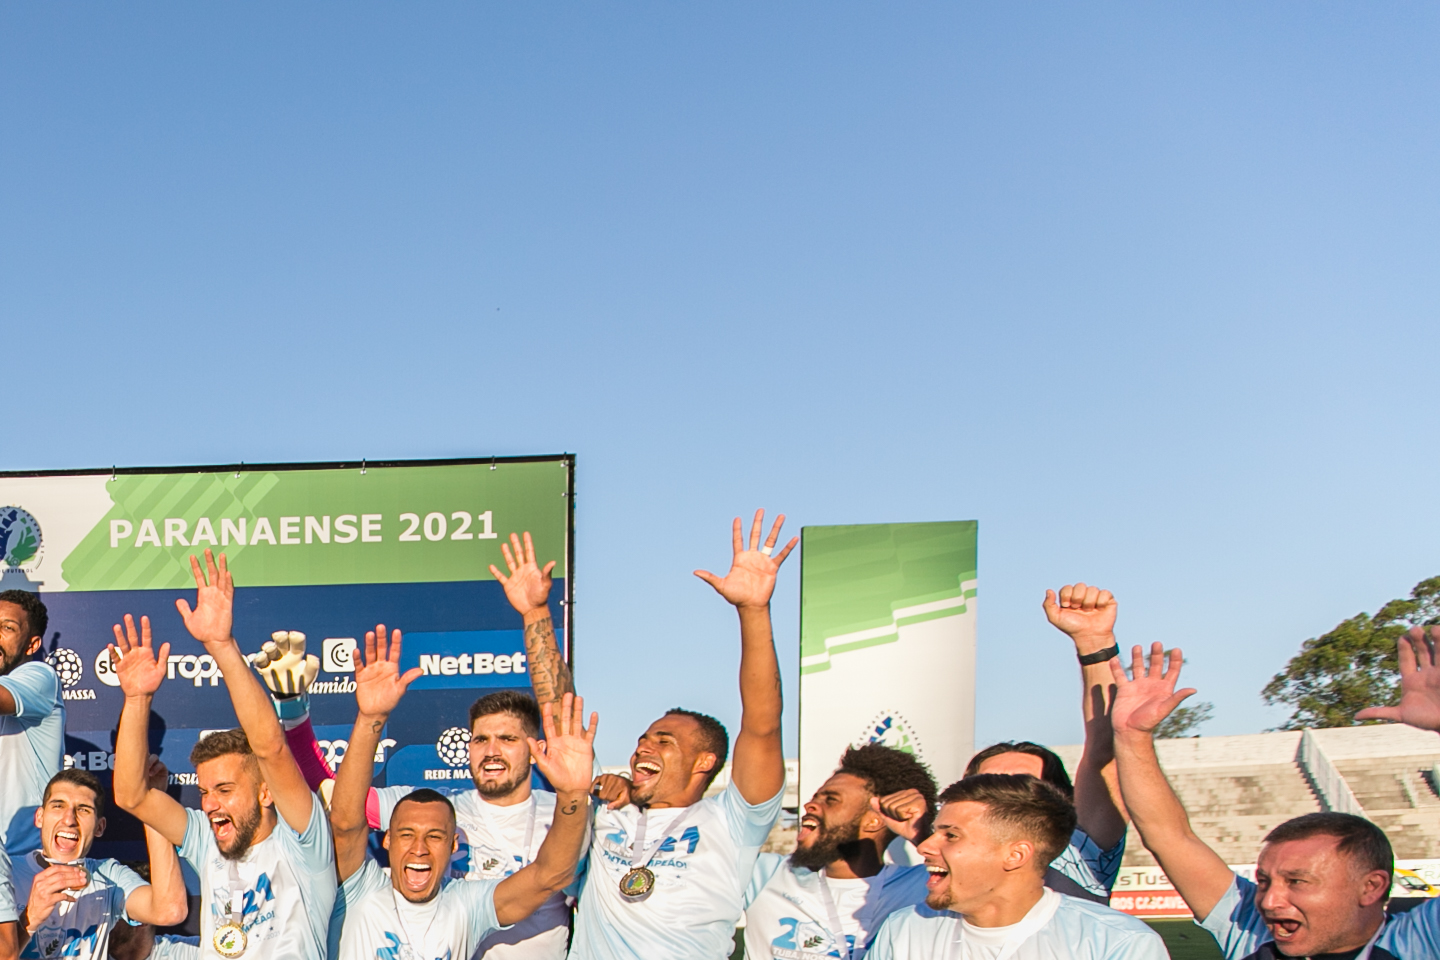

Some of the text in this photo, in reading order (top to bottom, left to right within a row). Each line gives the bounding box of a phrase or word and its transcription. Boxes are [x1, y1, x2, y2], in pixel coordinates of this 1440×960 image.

[109, 510, 498, 548] PARANAENSE 2021
[419, 651, 527, 676] NetBet
[424, 769, 472, 780] REDE MA
